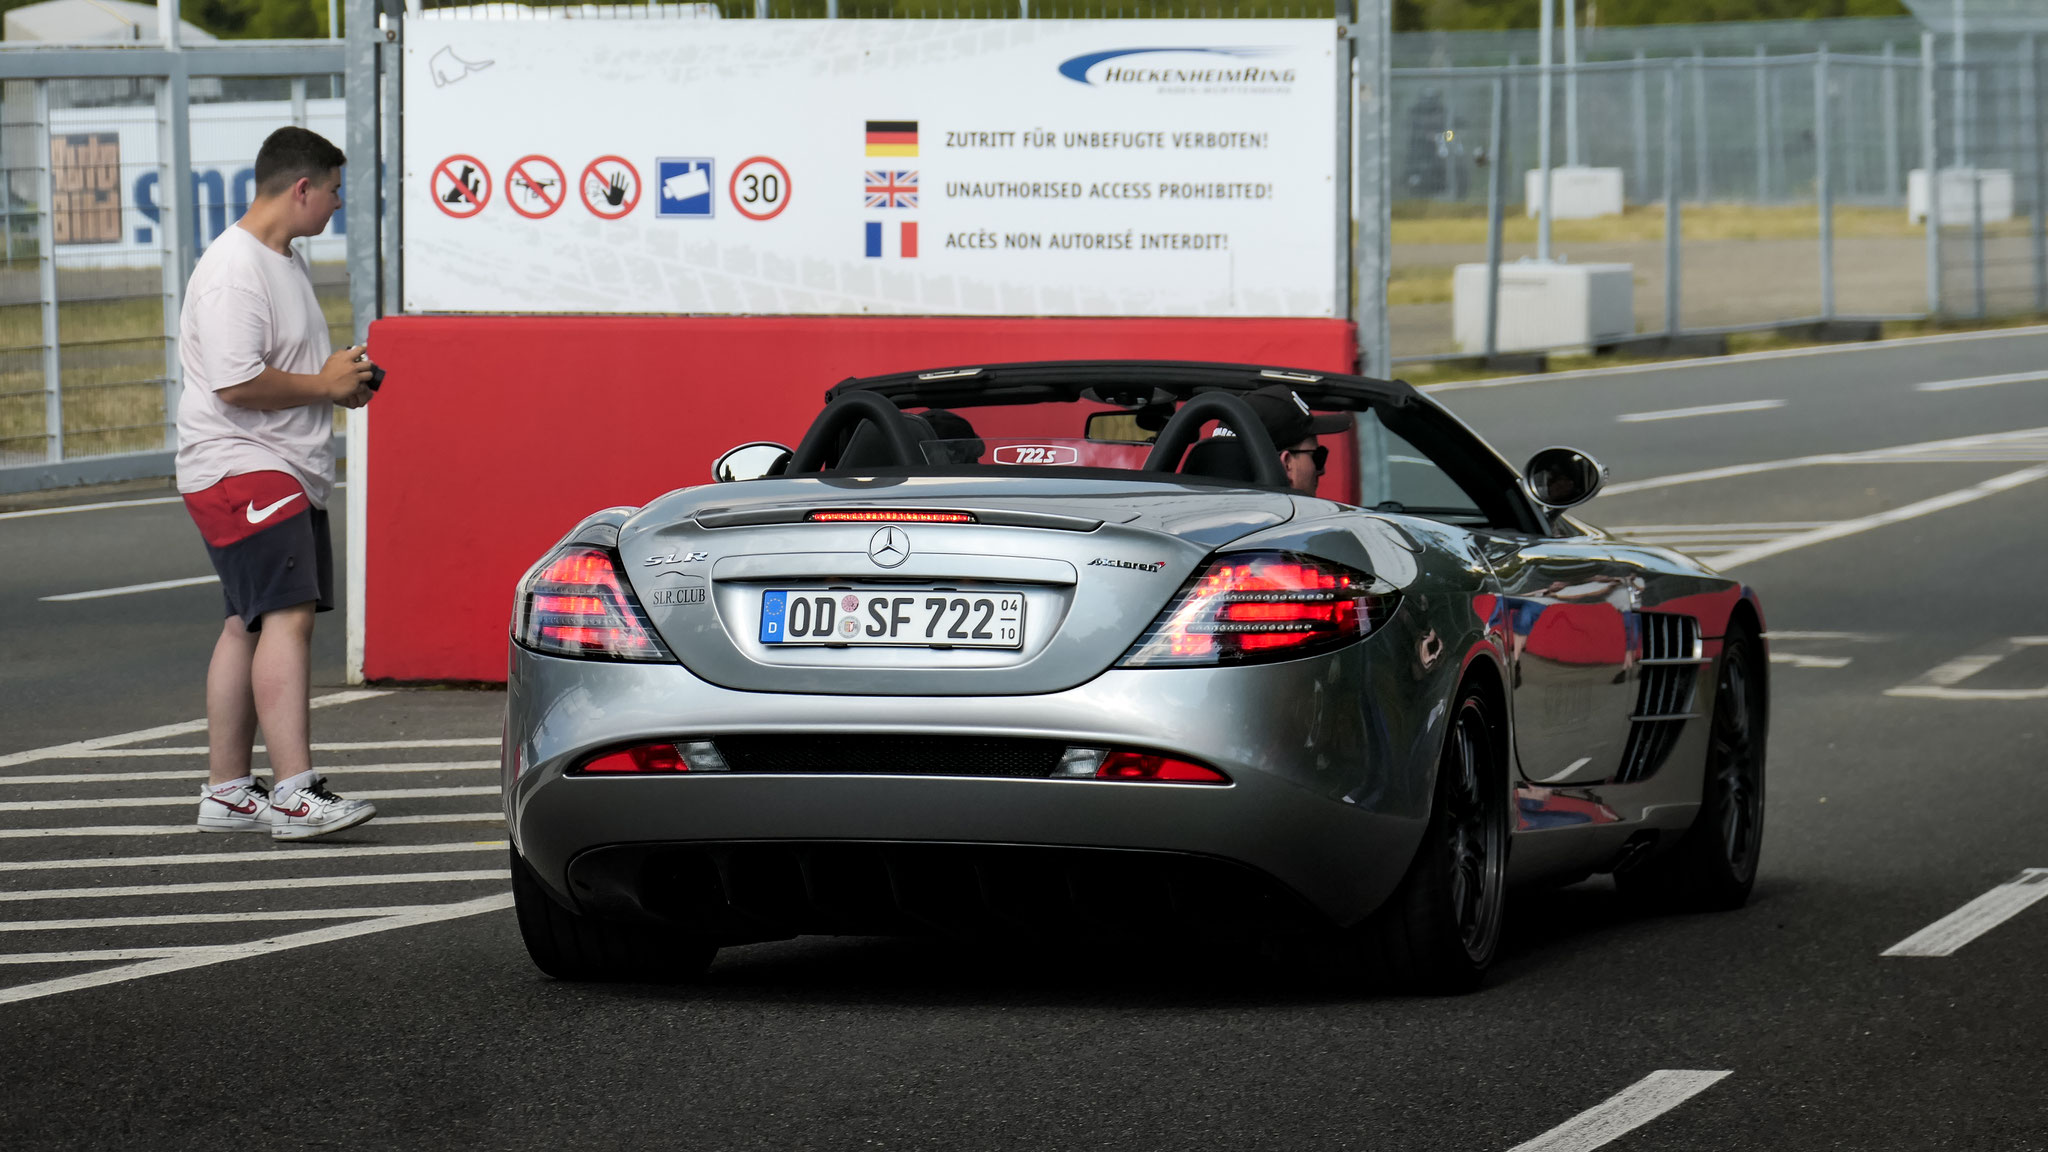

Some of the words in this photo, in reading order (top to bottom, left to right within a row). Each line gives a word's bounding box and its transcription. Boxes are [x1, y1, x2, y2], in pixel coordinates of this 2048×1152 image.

[946, 132, 1015, 147] ZUTRITT
[1023, 127, 1055, 147] FÜR
[1064, 132, 1164, 147] UNBEFUGTE
[1172, 132, 1268, 148] VERBOTEN!
[743, 174, 778, 203] 30
[946, 182, 1082, 198] UNAUTHORISED
[1089, 182, 1151, 198] ACCESS
[1159, 183, 1272, 199] PROHIBITED!
[946, 228, 997, 248] ACCÈS
[1005, 233, 1041, 248] NON
[1049, 228, 1132, 249] AUTORISÉ
[1141, 234, 1228, 250] INTERDIT!
[643, 551, 708, 567] SLR
[1087, 558, 1158, 573] McLaren
[676, 588, 706, 603] CLUB
[1001, 600, 1018, 611] 04
[789, 597, 836, 637] OD
[866, 597, 914, 637] SF
[925, 598, 994, 639] 722
[768, 622, 777, 633] D
[1000, 628, 1015, 639] 10
